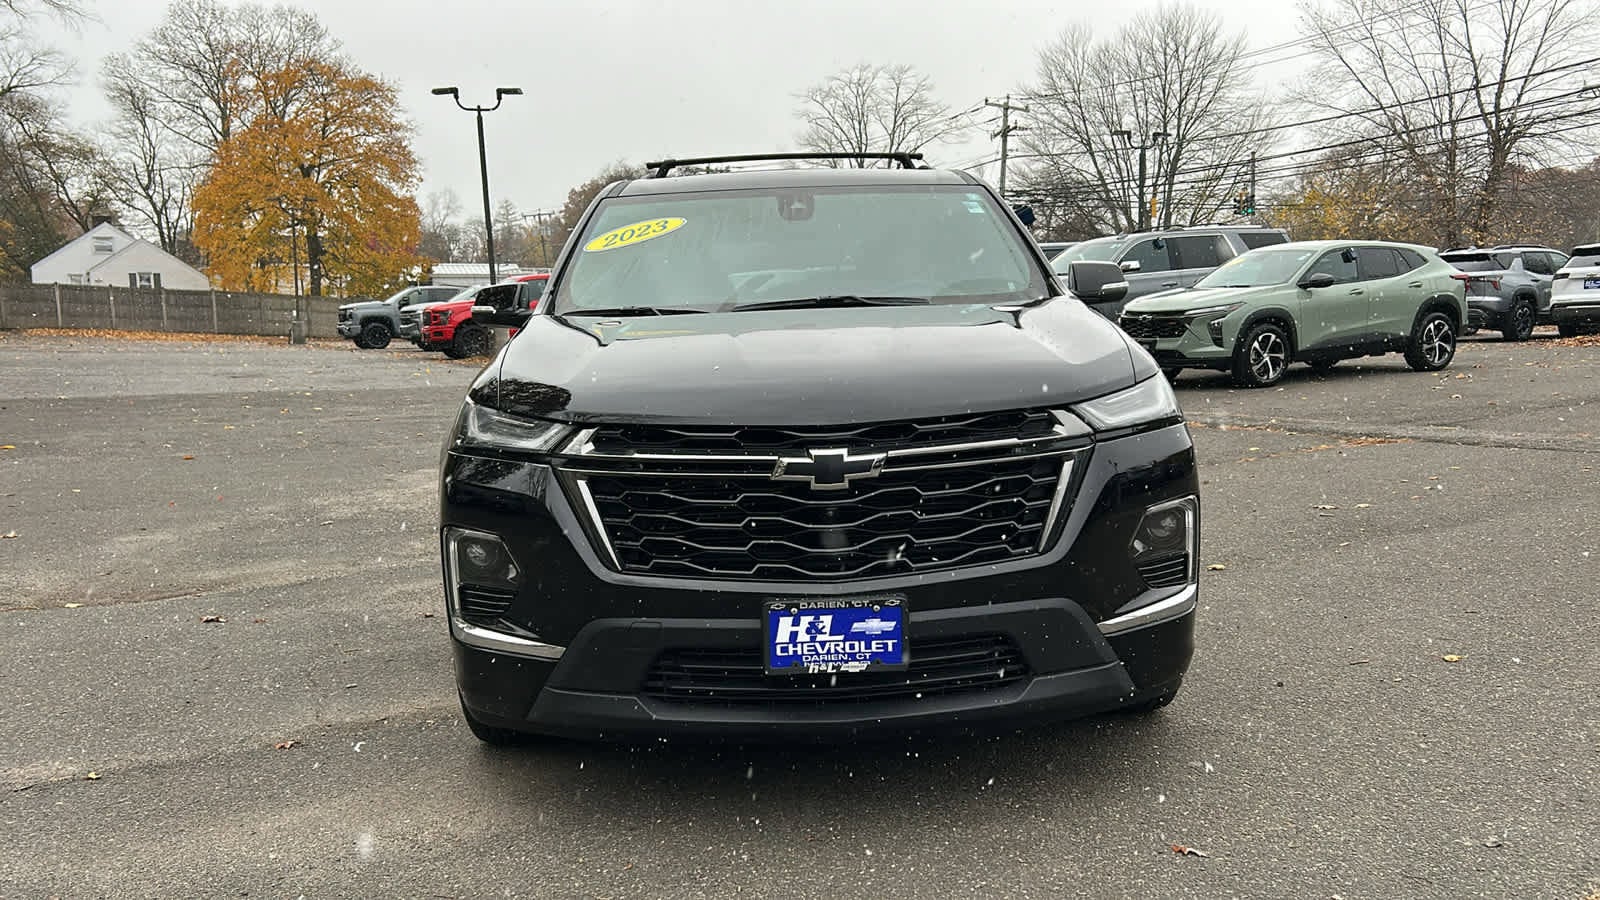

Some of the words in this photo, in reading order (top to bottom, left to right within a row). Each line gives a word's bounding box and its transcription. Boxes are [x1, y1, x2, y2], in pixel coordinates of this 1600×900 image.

[602, 219, 669, 248] 2023
[775, 615, 845, 643] H&L
[776, 640, 898, 656] CHEVROLET
